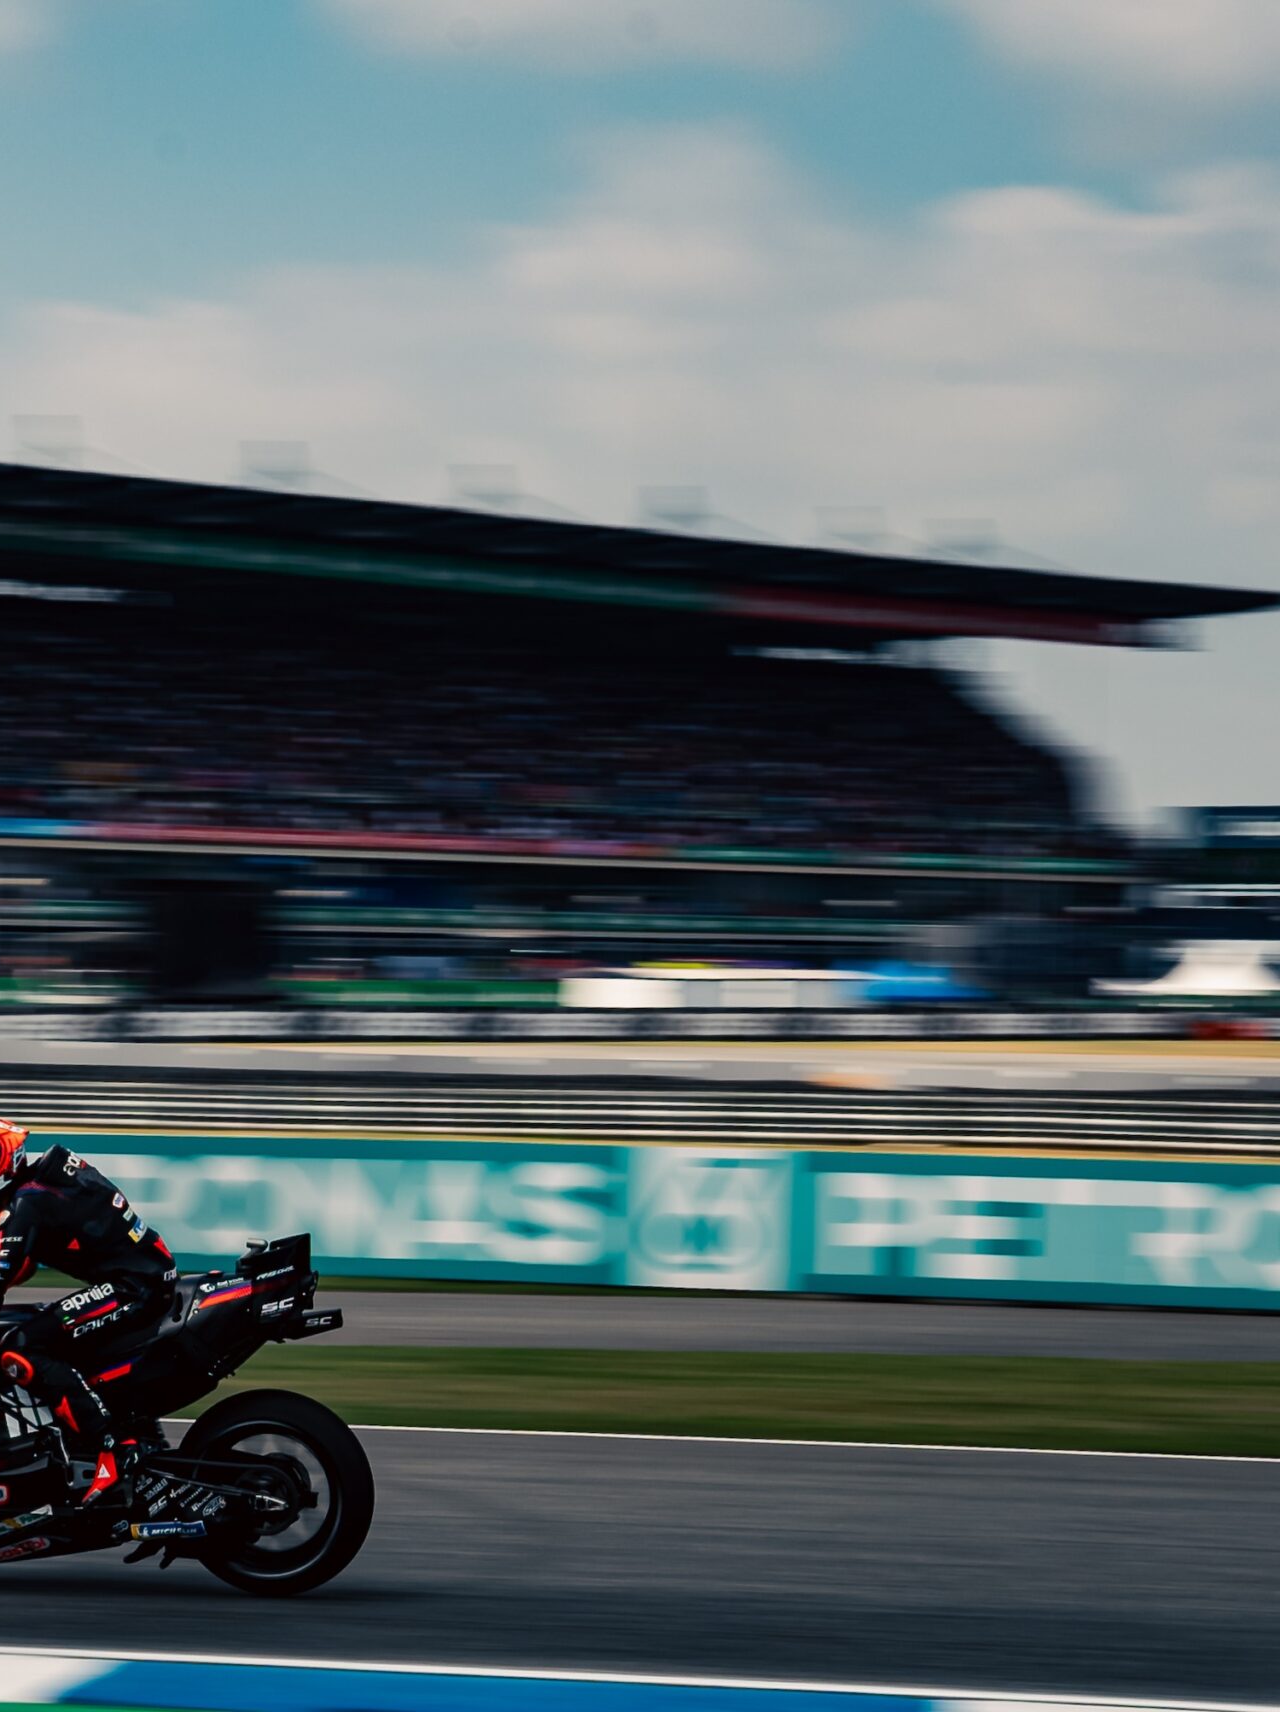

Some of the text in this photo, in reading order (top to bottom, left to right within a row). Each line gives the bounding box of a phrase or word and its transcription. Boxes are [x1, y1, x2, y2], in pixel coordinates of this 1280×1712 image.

[60, 1282, 115, 1312] aprilia
[260, 1296, 295, 1315] SC
[304, 1316, 333, 1327] SC
